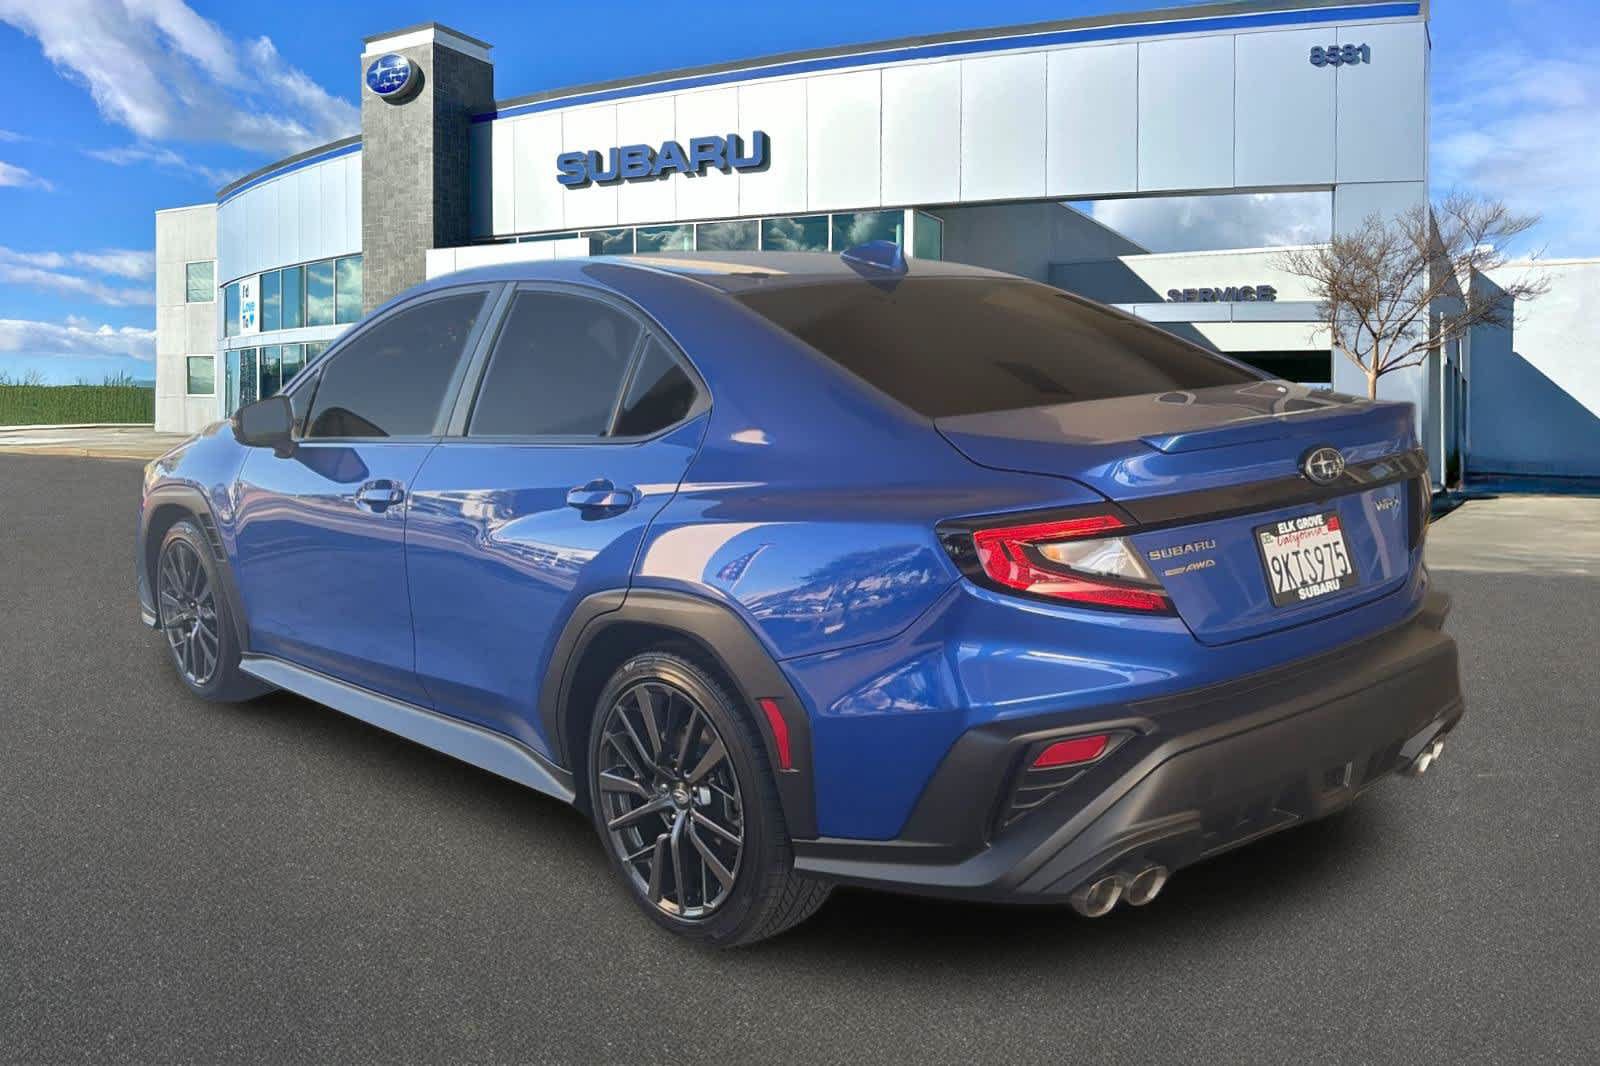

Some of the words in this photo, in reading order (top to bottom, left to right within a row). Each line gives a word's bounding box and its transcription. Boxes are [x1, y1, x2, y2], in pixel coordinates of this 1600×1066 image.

[556, 130, 770, 190] SUBARU
[1166, 285, 1277, 302] SERVICE
[1277, 520, 1297, 534] ELK
[1296, 514, 1324, 529] GROVE
[1149, 540, 1217, 560] SUBARU
[1185, 559, 1217, 573] AWD
[1271, 541, 1348, 593] 9KIS975
[1298, 579, 1340, 600] SUBARU
